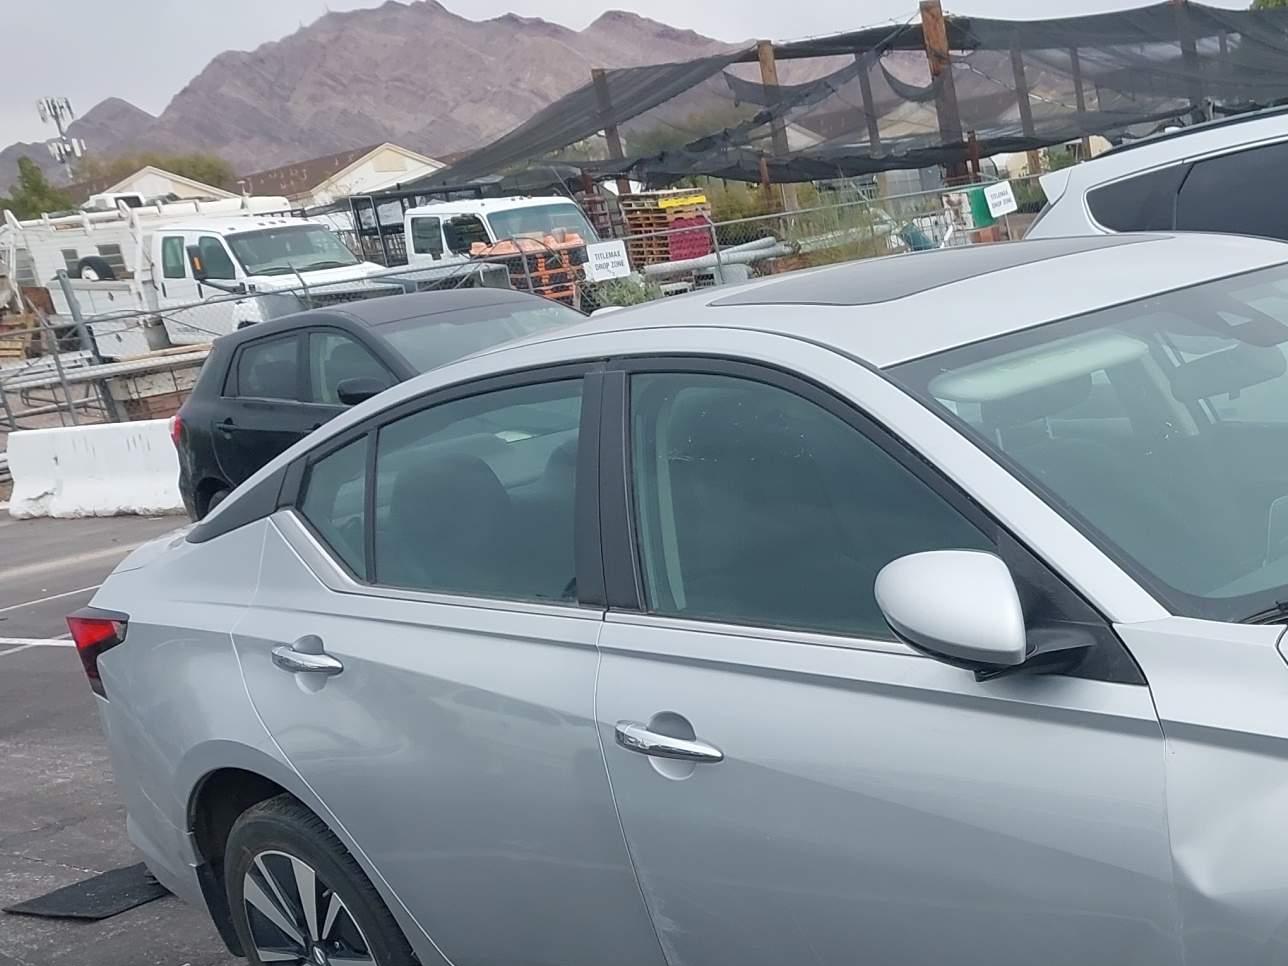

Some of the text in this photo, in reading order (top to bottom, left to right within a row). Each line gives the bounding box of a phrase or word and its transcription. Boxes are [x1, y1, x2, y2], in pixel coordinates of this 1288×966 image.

[594, 250, 620, 260] TITLEMAX
[594, 260, 624, 270] DROP ZONE
